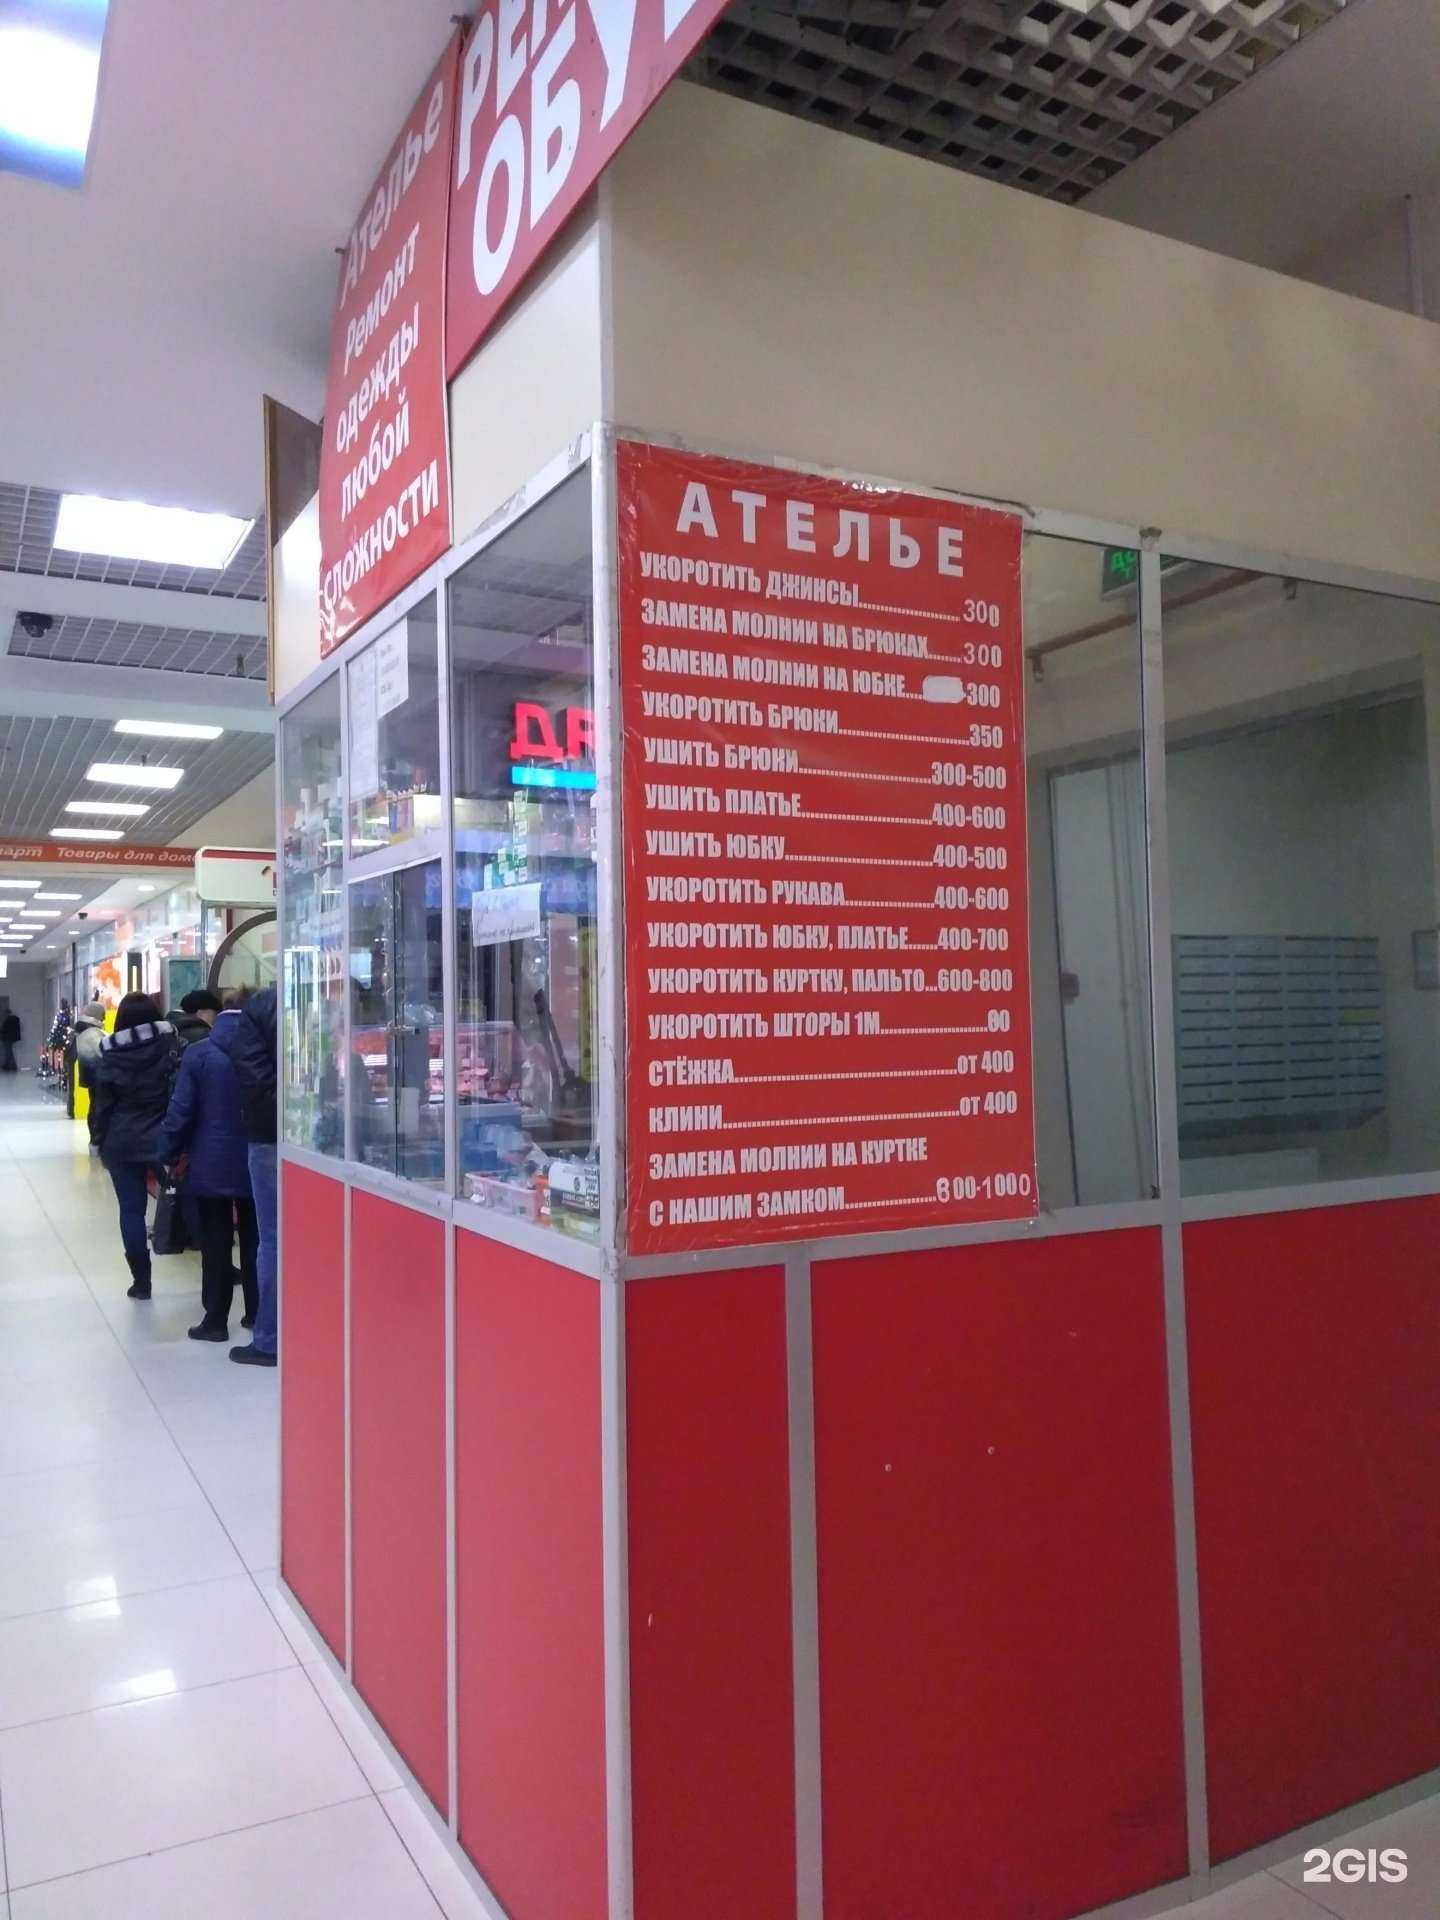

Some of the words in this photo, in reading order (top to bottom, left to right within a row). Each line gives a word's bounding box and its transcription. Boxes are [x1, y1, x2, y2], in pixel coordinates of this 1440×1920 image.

[340, 80, 444, 311] Ателье
[344, 222, 420, 376] Ремонт
[336, 302, 419, 453] одежды
[341, 386, 409, 522] любой
[676, 480, 965, 578] АТЕЛЬЕ
[639, 551, 762, 593] УКОРОТИТЬ
[765, 570, 859, 608] ДЖИНСЫ
[962, 599, 1000, 628] 300
[641, 597, 728, 634] ЗАМЕНА
[732, 609, 818, 645] МОЛНИИ
[822, 622, 849, 649] НА
[851, 627, 930, 660] БРЮКАХ
[963, 642, 1002, 668] 300
[641, 644, 729, 679] ЗАМЕНА
[732, 655, 819, 689] МОЛНИИ
[823, 665, 849, 692] НА
[852, 669, 906, 698] ЮБКЕ
[966, 682, 1001, 708] 300
[641, 690, 764, 727] УКОРОТИТЬ
[767, 703, 839, 734] БРЮКИ
[969, 723, 1003, 749] 350
[643, 736, 720, 768] УШИТЬ
[724, 744, 799, 774] БРЮКИ
[929, 761, 1007, 790] 300-500
[644, 783, 721, 813] УШИТЬ
[725, 788, 802, 818] ПЛАТЬЕ
[930, 802, 1006, 830] 400-600
[57, 847, 119, 861] Товары
[645, 829, 722, 858] УШИТЬ
[726, 833, 785, 861] ЮБКУ
[931, 844, 1008, 870] 400-500
[646, 875, 767, 904] УКОРОТИТЬ
[771, 879, 846, 906] РУКАВА
[932, 886, 1009, 911] 400-600
[646, 921, 768, 949] УКОРОТИТЬ
[772, 924, 834, 952] ЮБКУ,
[837, 925, 909, 950] ПЛАТЬЕ
[935, 927, 1009, 951] 400-700
[647, 967, 769, 994] УКОРОТИТЬ
[772, 968, 848, 995] КУРТКУ,
[851, 968, 925, 993] ПАЛЬТО
[937, 968, 1013, 993] 600-800
[647, 1012, 769, 1040] УКОРОТИТЬ
[773, 1011, 851, 1037] ШТОРЫ
[648, 1055, 736, 1087] СТЁЖКА
[980, 1049, 1014, 1074] 400
[983, 1090, 1018, 1115] 400
[649, 1149, 736, 1180] ЗАМЕНА
[740, 1143, 827, 1174] МОЛНИИ
[831, 1141, 858, 1167] НА
[861, 1137, 928, 1165] КУРТКЕ
[649, 1200, 664, 1227] С
[669, 1193, 752, 1225] НАШИМ
[756, 1186, 845, 1218] ЗАМКОМ
